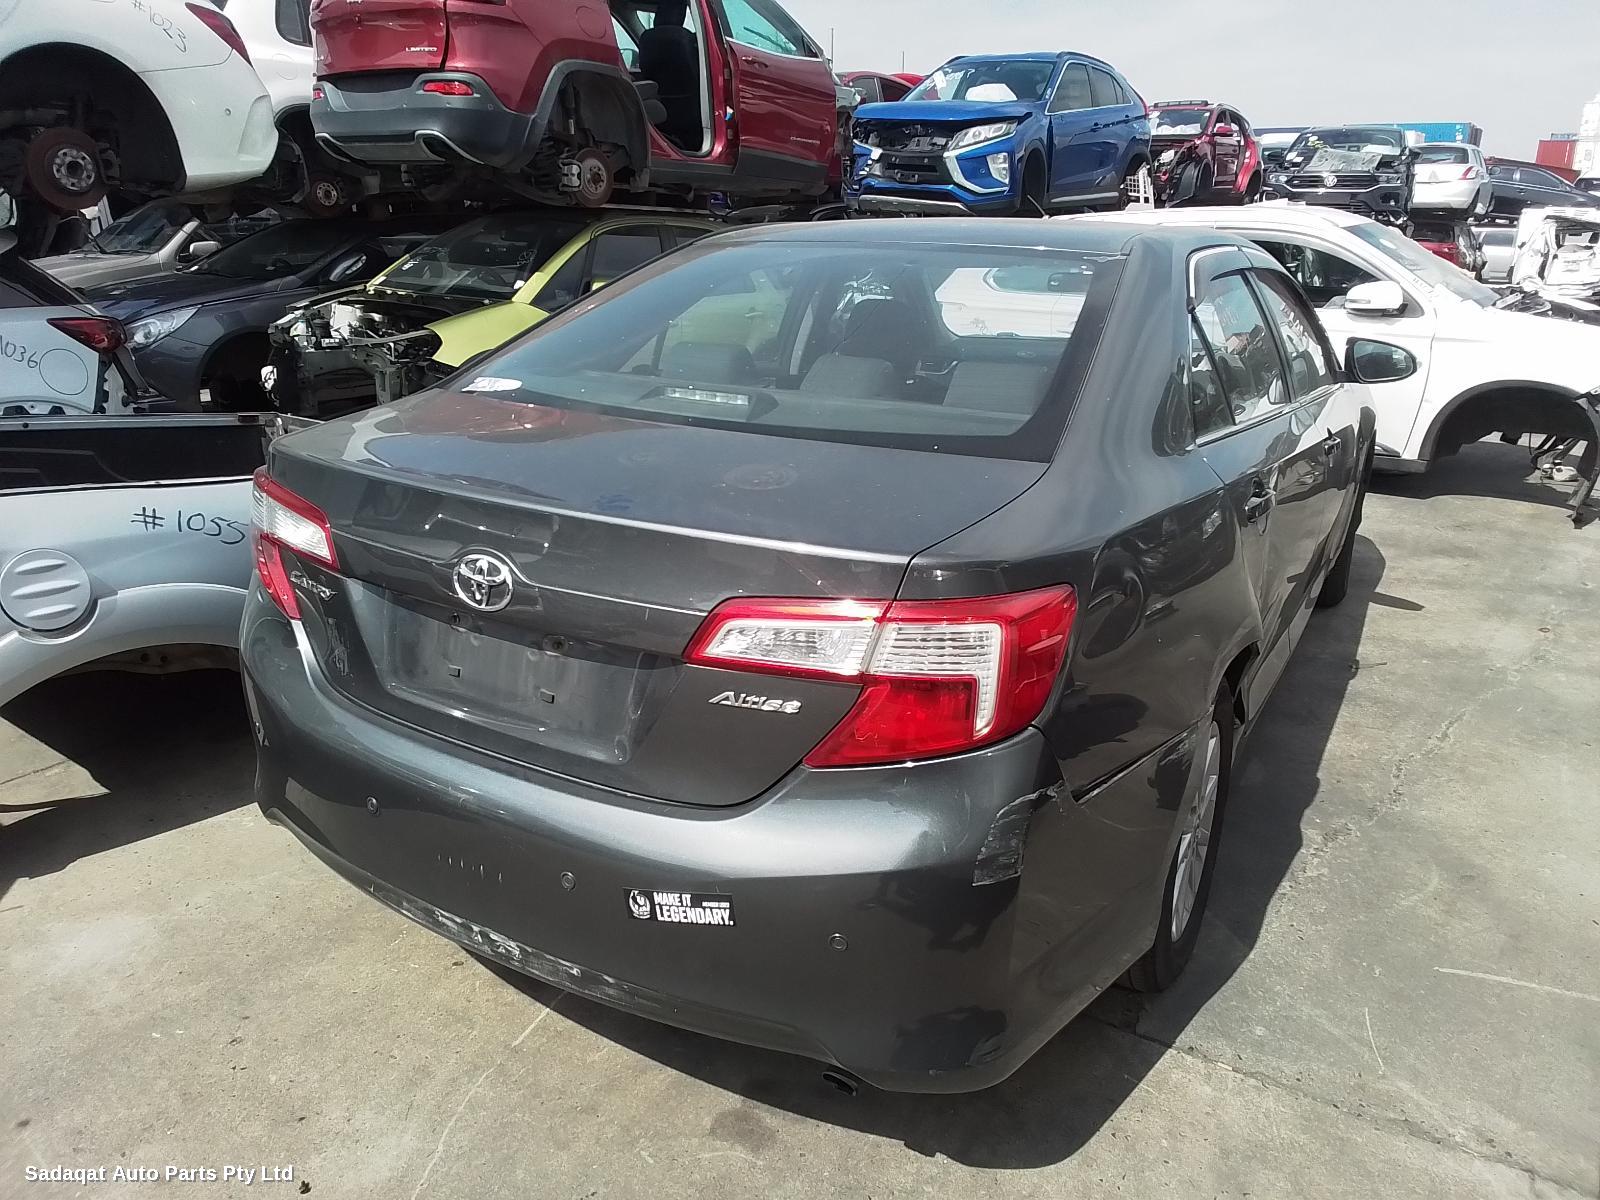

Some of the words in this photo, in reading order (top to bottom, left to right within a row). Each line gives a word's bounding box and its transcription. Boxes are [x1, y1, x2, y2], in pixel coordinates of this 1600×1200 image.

[652, 891, 681, 906] MAKE
[681, 893, 692, 907] IT
[655, 904, 734, 926] LEGENDARY.
